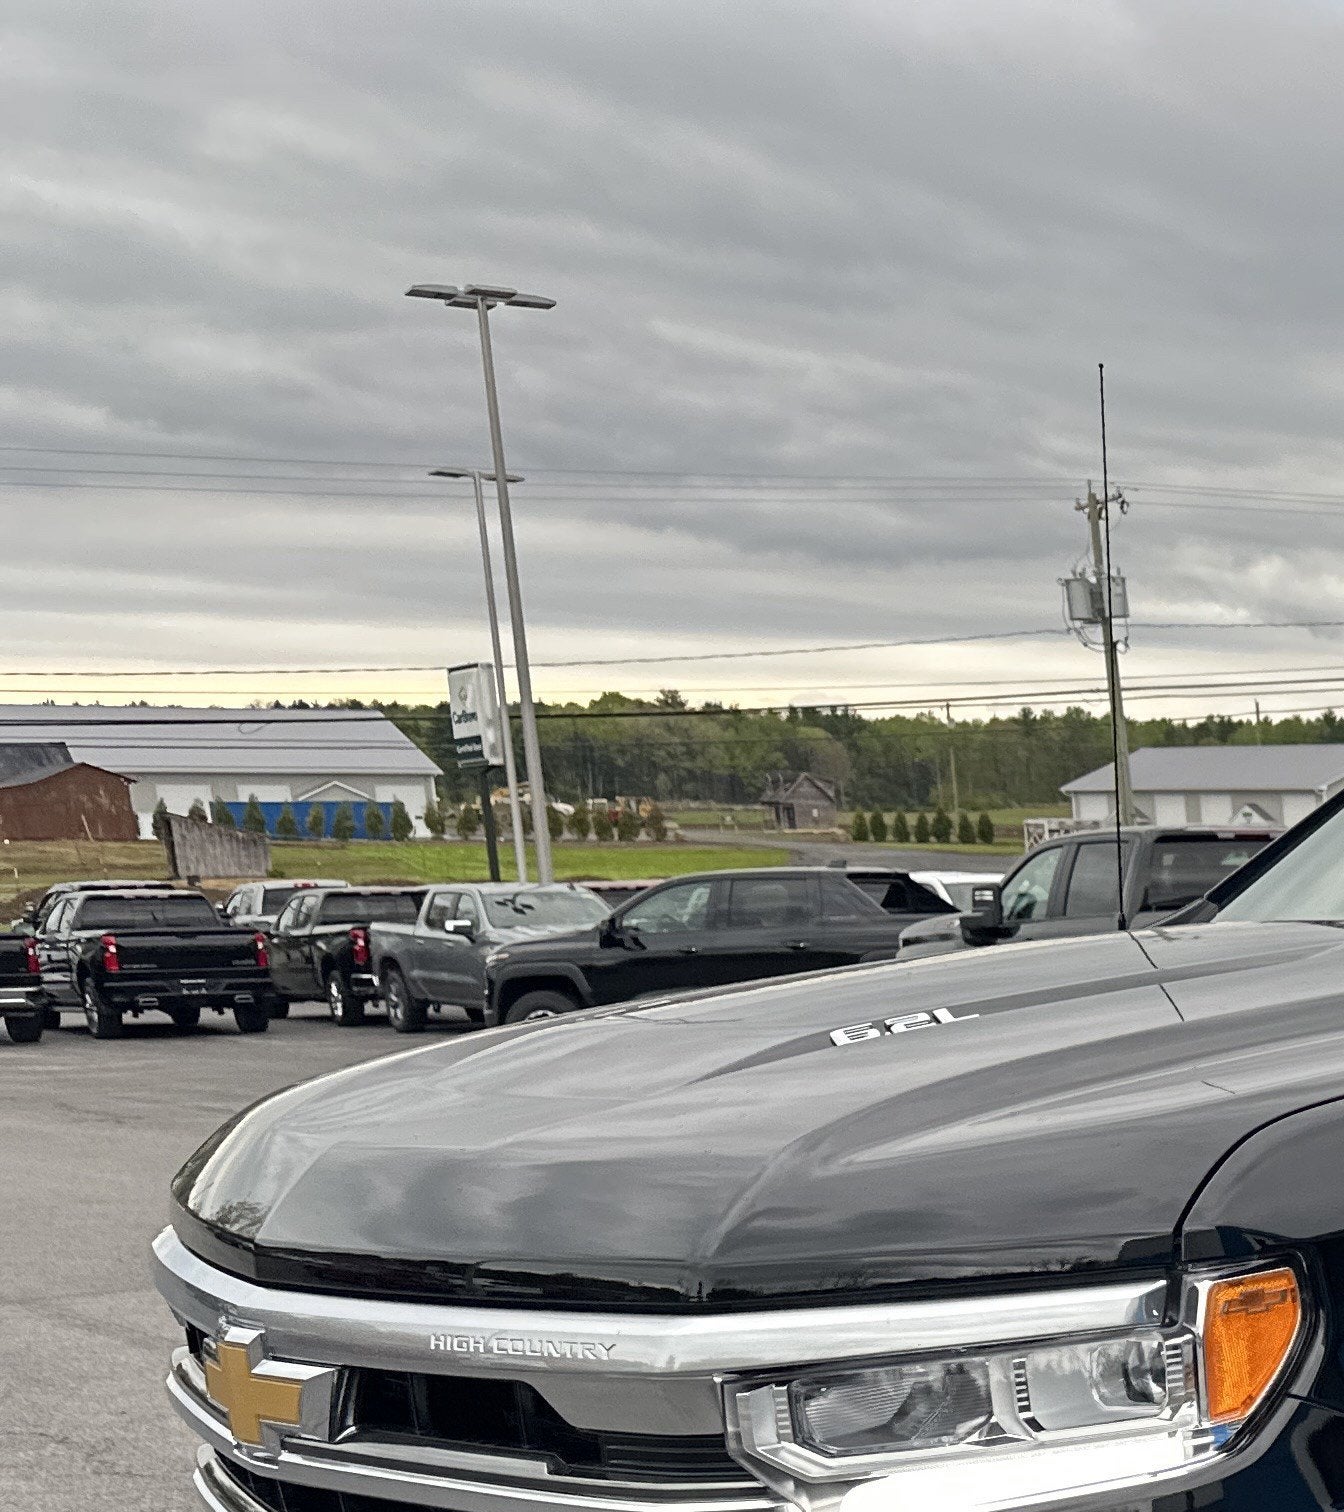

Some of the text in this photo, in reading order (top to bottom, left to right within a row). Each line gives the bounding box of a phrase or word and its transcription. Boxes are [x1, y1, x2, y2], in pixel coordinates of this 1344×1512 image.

[829, 1007, 980, 1047] 6.2L
[429, 1333, 616, 1361] HIGH COUNTRY
